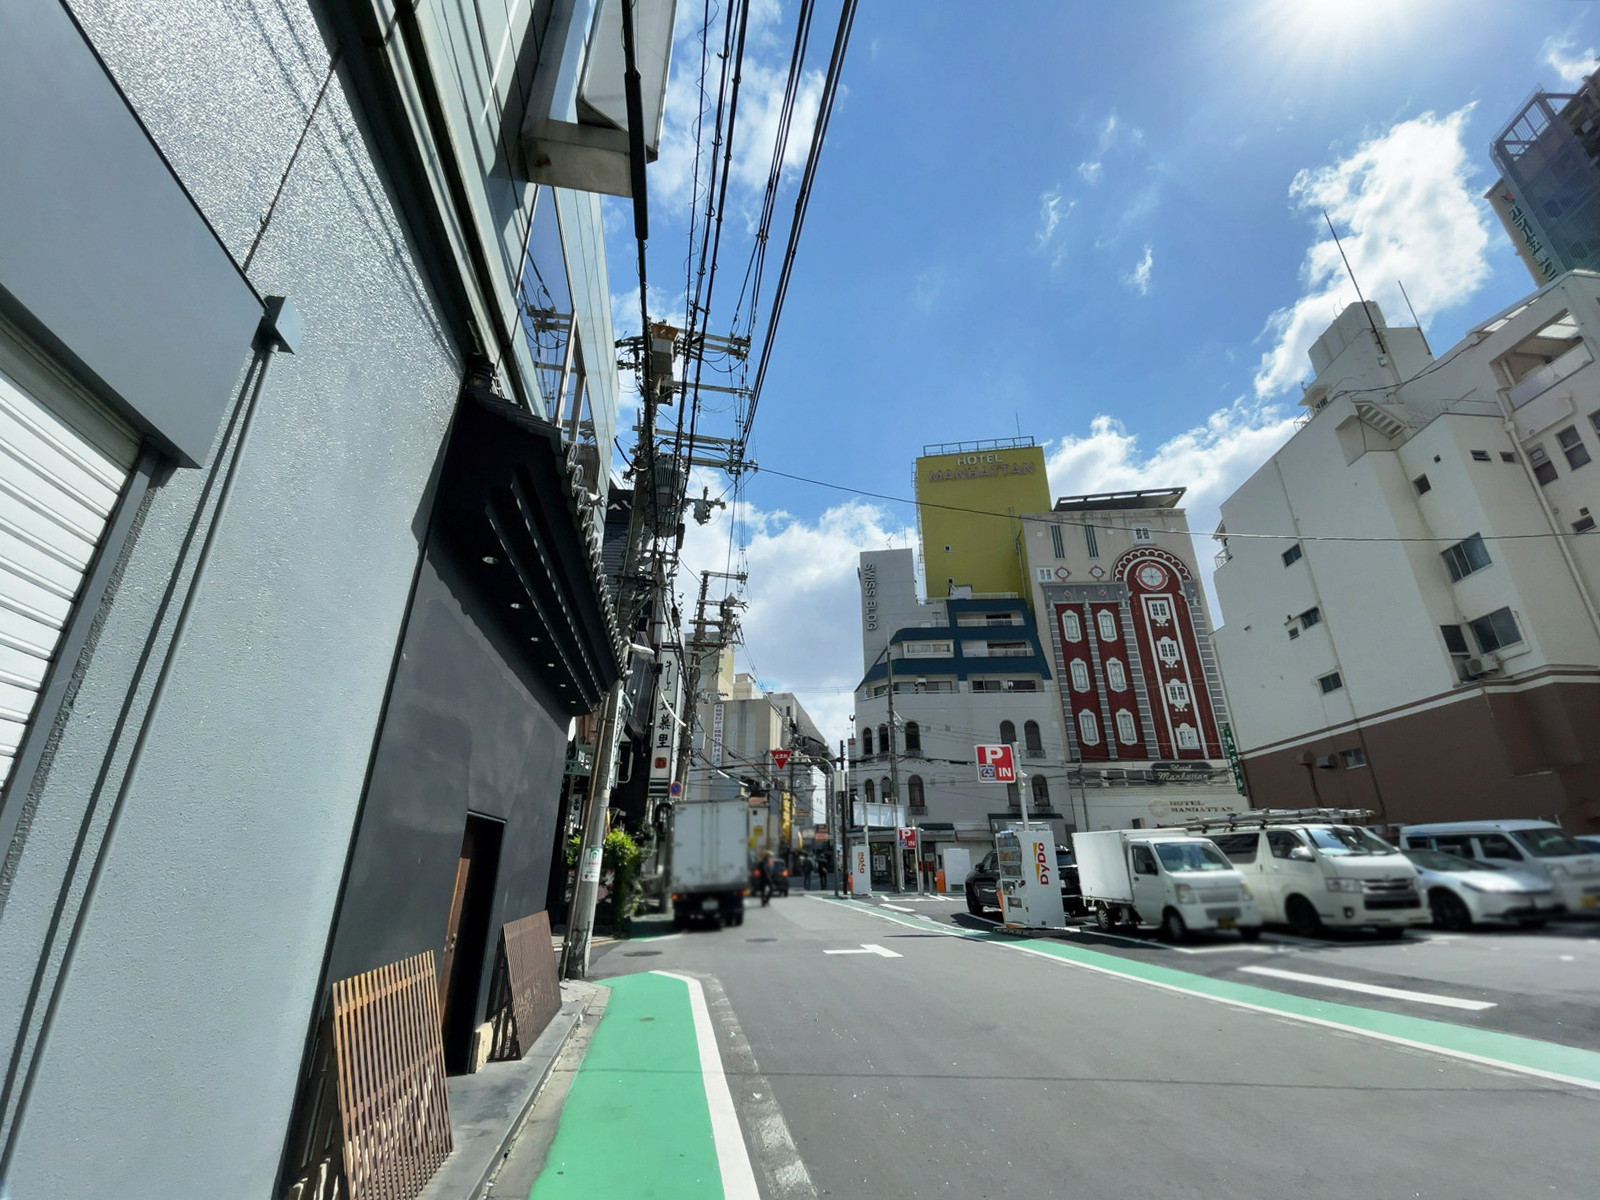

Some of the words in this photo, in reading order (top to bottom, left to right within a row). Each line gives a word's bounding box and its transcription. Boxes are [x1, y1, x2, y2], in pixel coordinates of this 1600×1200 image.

[956, 453, 1002, 466] HOTEL
[928, 462, 1036, 482] MANHATTAN
[864, 563, 876, 597] SWISS
[866, 601, 878, 631] BLDG
[985, 746, 1004, 764] P
[998, 767, 1012, 777] IN
[901, 829, 912, 840] P
[1037, 842, 1050, 885] DyDo
